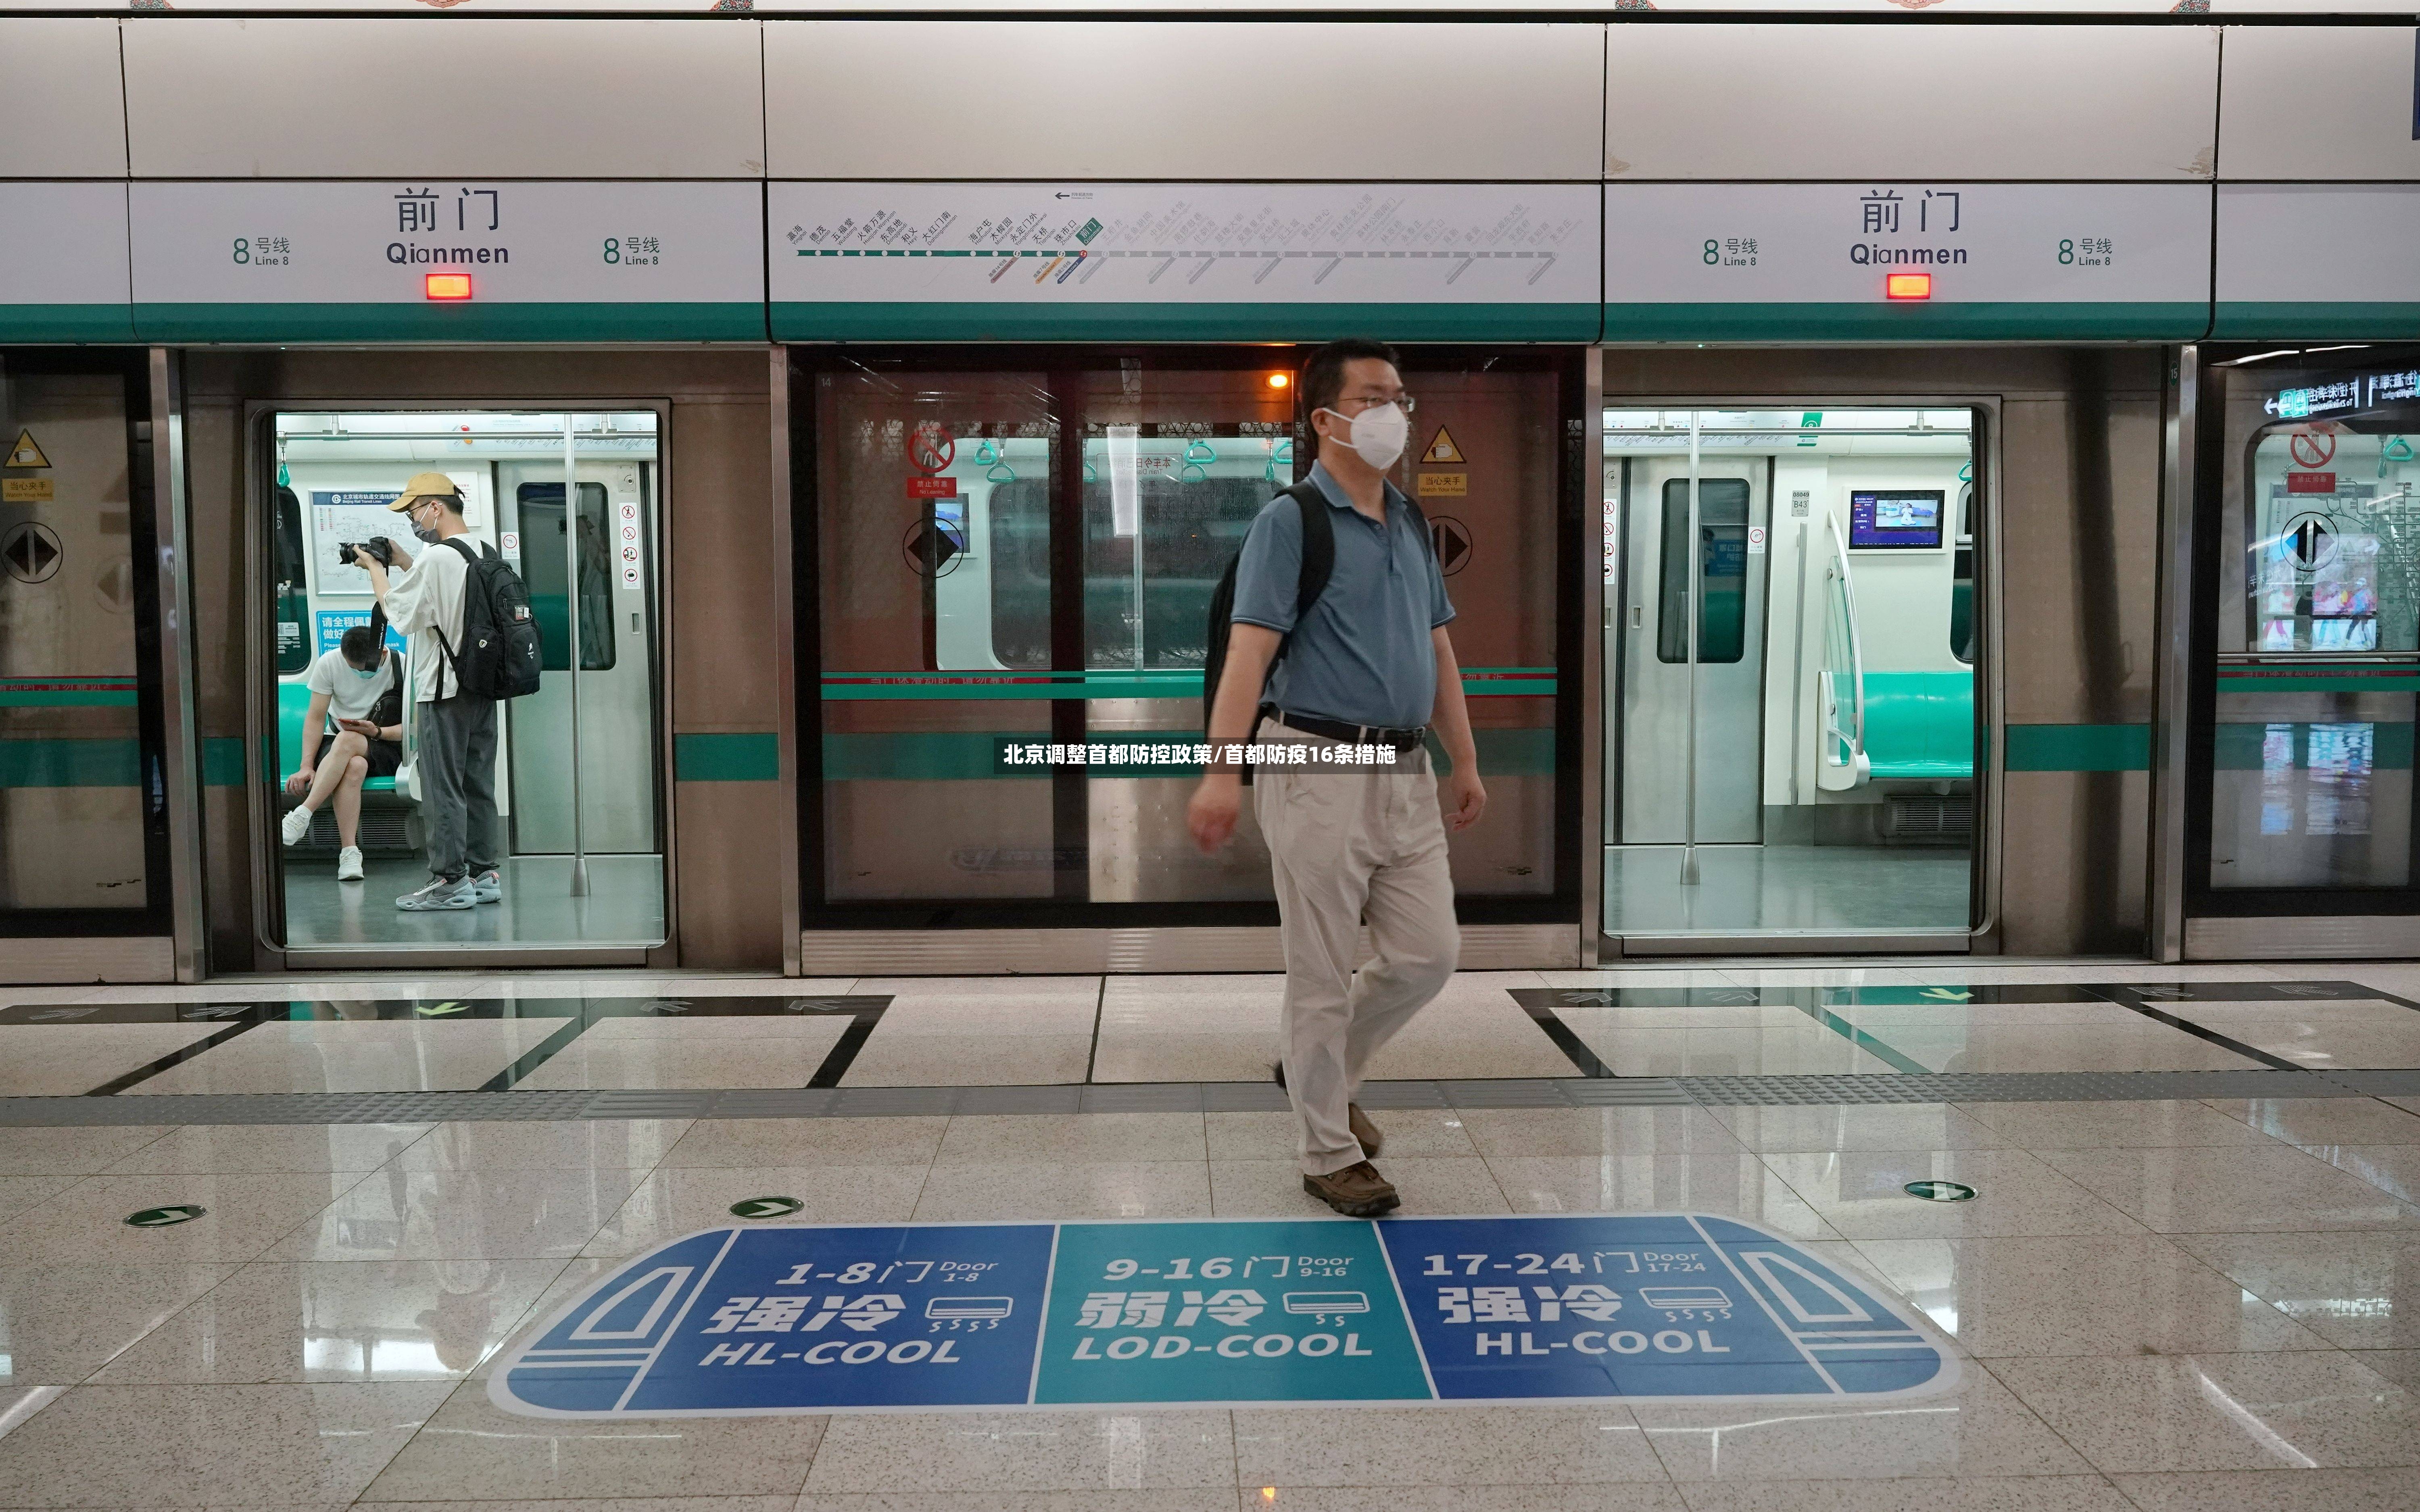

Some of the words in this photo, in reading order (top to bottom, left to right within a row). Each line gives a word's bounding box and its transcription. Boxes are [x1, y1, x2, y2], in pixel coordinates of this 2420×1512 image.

[394, 187, 498, 232] 前门
[1860, 190, 1959, 233] 前门
[809, 225, 826, 242] 德茂
[831, 218, 854, 242] 五福堂
[857, 210, 886, 241] 火箭万源
[880, 219, 903, 242] 东高地
[886, 222, 908, 245] Donggaodi
[922, 210, 951, 242] 大红门南
[968, 219, 991, 243] 海户屯
[1010, 212, 1037, 242] 永定门外
[1054, 220, 1076, 242] 珠市口
[1079, 221, 1096, 239] 前门
[792, 231, 807, 245] Yinghai
[816, 230, 830, 244] Demao
[901, 227, 918, 243] 和义
[908, 236, 918, 246] Heyi
[995, 226, 1014, 245] Muxiyuan
[1032, 227, 1048, 244] 天桥
[256, 257, 278, 265] Line
[283, 256, 289, 265] 8
[387, 243, 508, 264] Qianmen
[626, 256, 648, 264] Line
[653, 256, 658, 264] 8
[1725, 257, 1747, 265] Line
[1750, 257, 1756, 265] 8
[1850, 244, 1966, 265] Qianmen
[2079, 257, 2101, 265] Line
[2105, 257, 2111, 265] 8
[821, 377, 831, 387] 14
[10, 482, 46, 490] 当心夹手
[1425, 477, 1460, 485] 当心夹手
[1298, 1256, 1354, 1266] Door
[1644, 1252, 1699, 1262] Door
[939, 1262, 998, 1272] Door
[1301, 1267, 1346, 1277] 9-16
[1648, 1263, 1706, 1272] 17-24
[944, 1273, 979, 1282] 1-8
[1074, 1289, 1268, 1329] 弱冷
[1438, 1285, 1623, 1323] 强冷
[700, 1294, 906, 1333] 强冷
[1072, 1333, 1372, 1360] LOD-COOL
[1477, 1330, 1730, 1355] HL-COOL
[698, 1340, 960, 1366] HL-COOL
